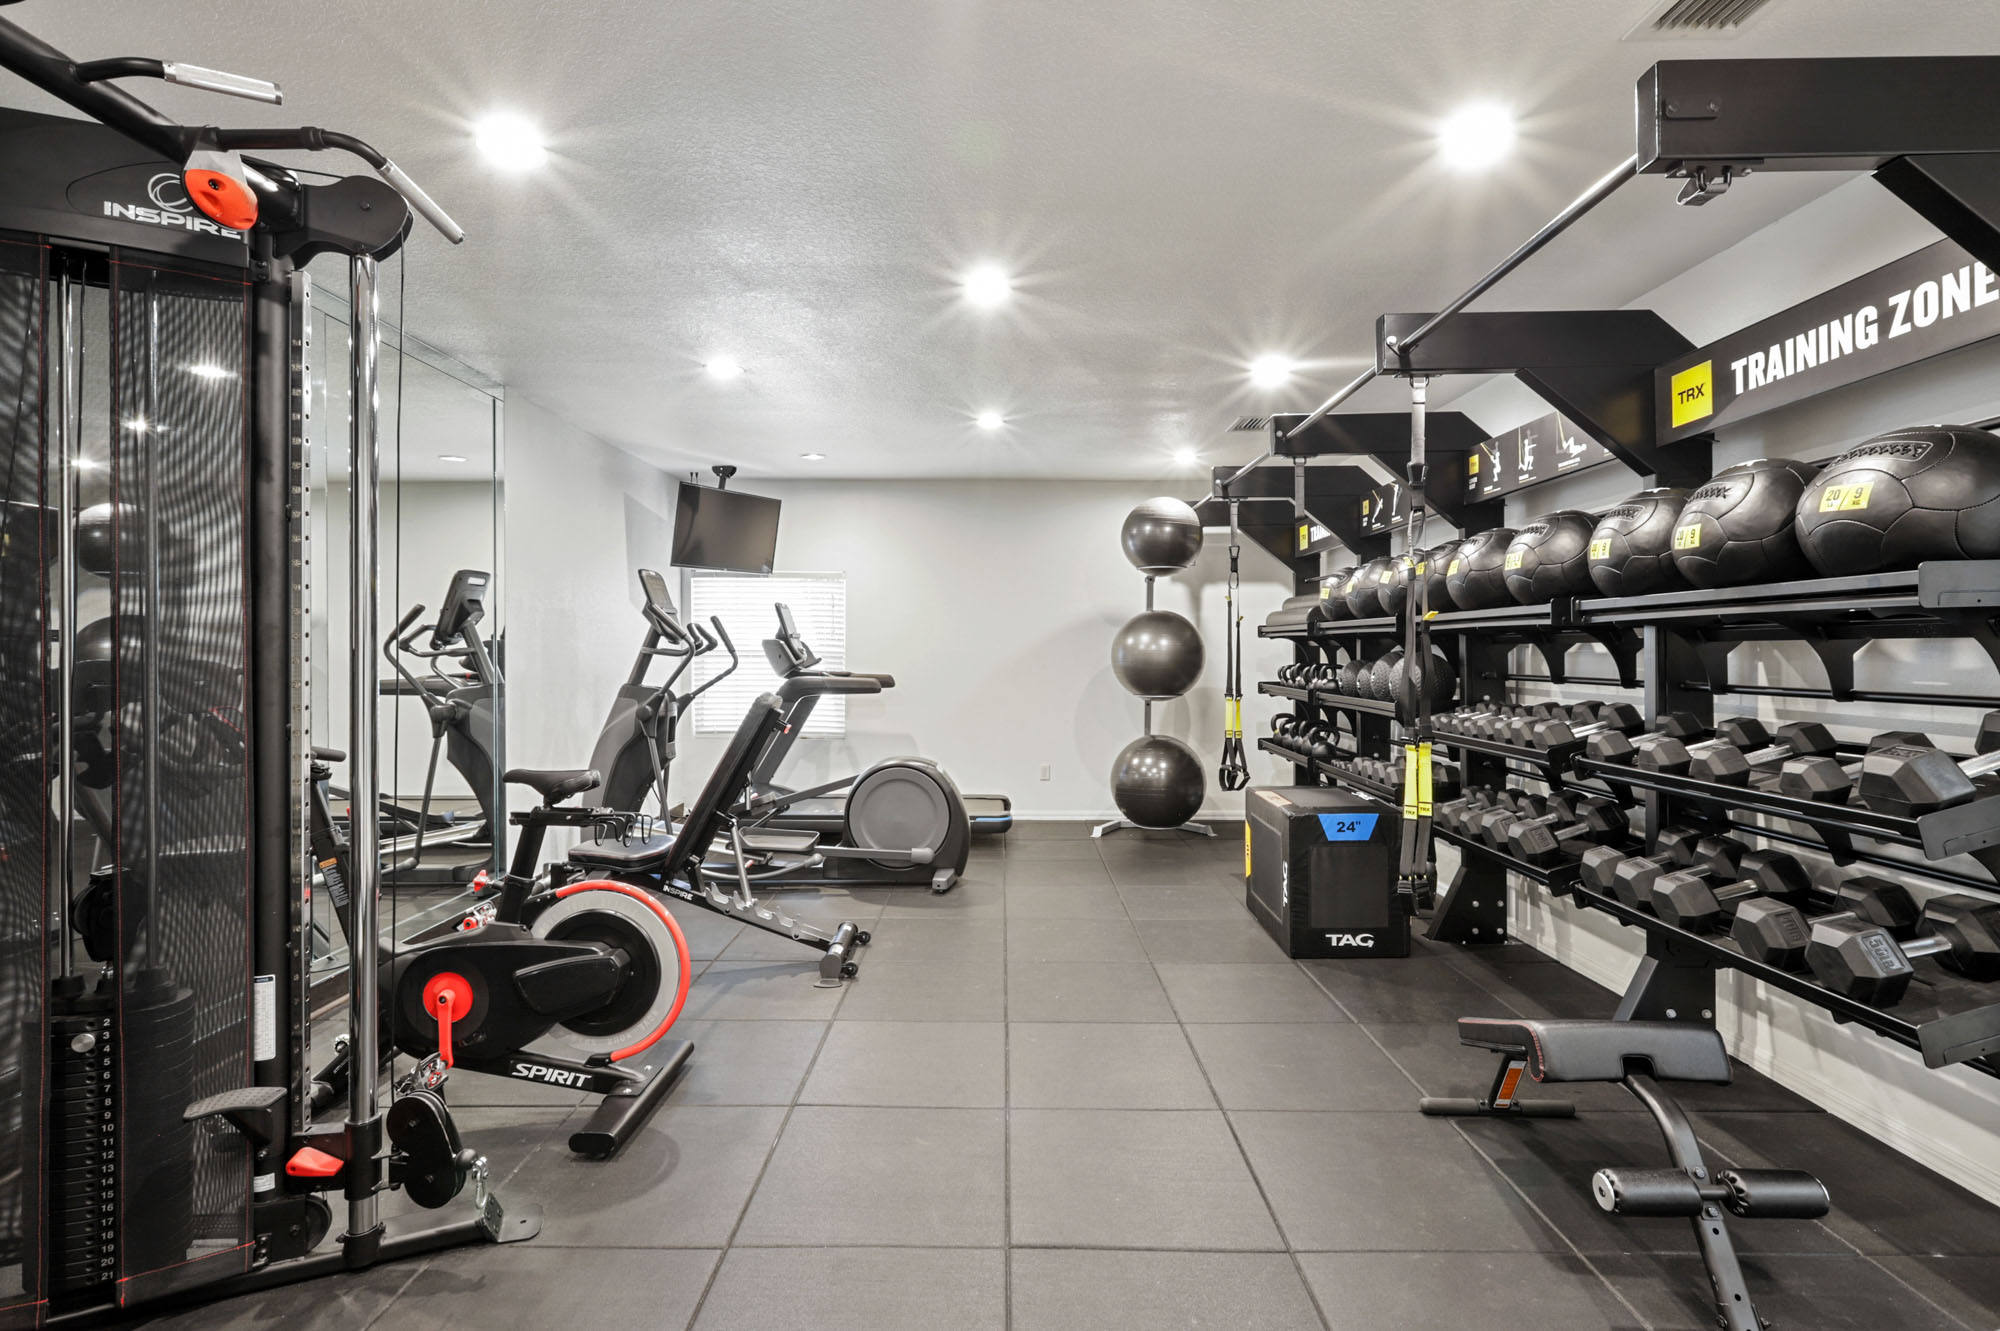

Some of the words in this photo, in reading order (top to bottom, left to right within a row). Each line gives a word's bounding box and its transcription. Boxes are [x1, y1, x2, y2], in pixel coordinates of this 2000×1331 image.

[103, 201, 241, 240] INSPIRE
[1730, 305, 1879, 395] TRAINING
[1888, 261, 2000, 339] ZONE
[1677, 383, 1705, 405] TRX
[1826, 489, 1841, 501] 20
[1854, 487, 1864, 499] 9
[1336, 821, 1361, 833] 24"
[662, 884, 693, 900] INSPIRE
[1325, 933, 1374, 947] TAG
[103, 1031, 110, 1039] 3
[103, 1058, 110, 1066] 5
[103, 1071, 110, 1079] 6
[511, 1063, 593, 1087] SPIRIT
[104, 1084, 111, 1092] 7
[104, 1098, 112, 1106] 8
[104, 1111, 111, 1119] 9
[101, 1124, 114, 1132] 10
[102, 1137, 114, 1146] 11
[102, 1151, 114, 1159] 12
[102, 1164, 114, 1173] 13
[101, 1177, 114, 1186] 14
[101, 1190, 114, 1199] 15
[101, 1203, 114, 1212] 16
[101, 1217, 114, 1226] 17
[101, 1231, 114, 1240] 18
[101, 1244, 114, 1253] 19
[101, 1257, 114, 1266] 20
[101, 1271, 114, 1281] 21
